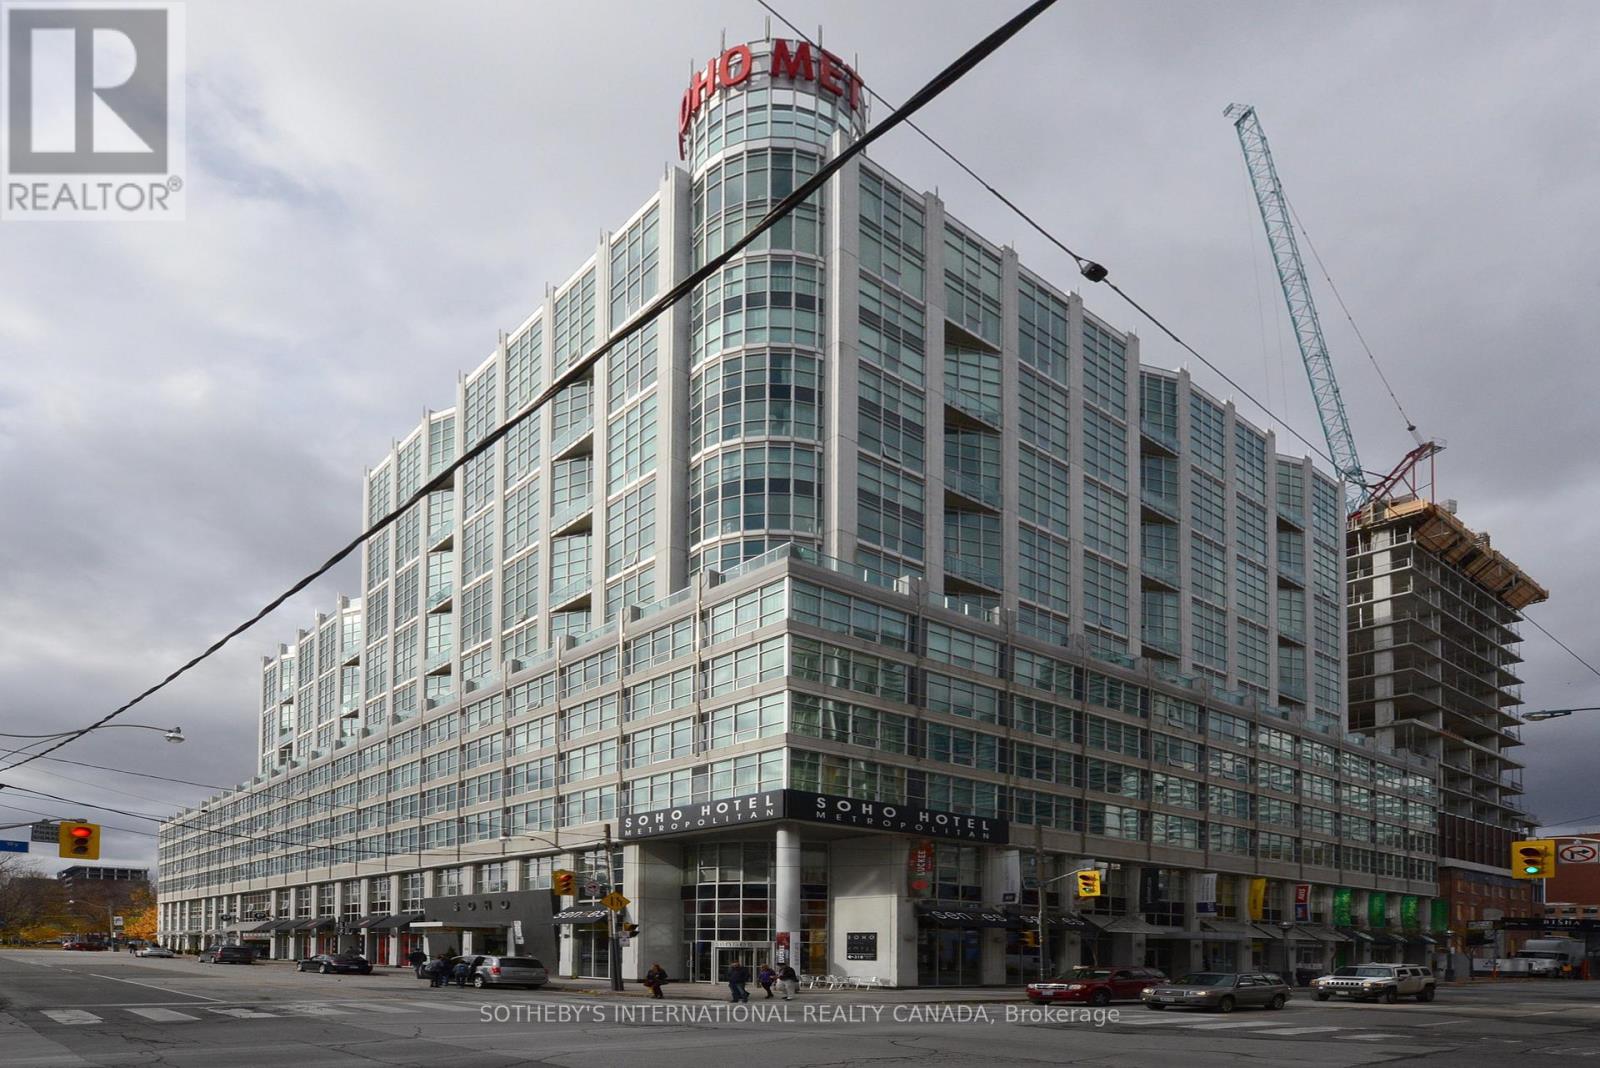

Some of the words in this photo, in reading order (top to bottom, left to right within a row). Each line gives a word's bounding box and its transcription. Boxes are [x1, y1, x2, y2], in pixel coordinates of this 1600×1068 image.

[625, 809, 682, 828] SOHO
[701, 795, 774, 816] HOTEL
[625, 808, 774, 837] METROPOLITAN
[816, 797, 897, 818] SOHO
[919, 811, 990, 831] HOTEL
[816, 810, 990, 840] METROPOLITAN
